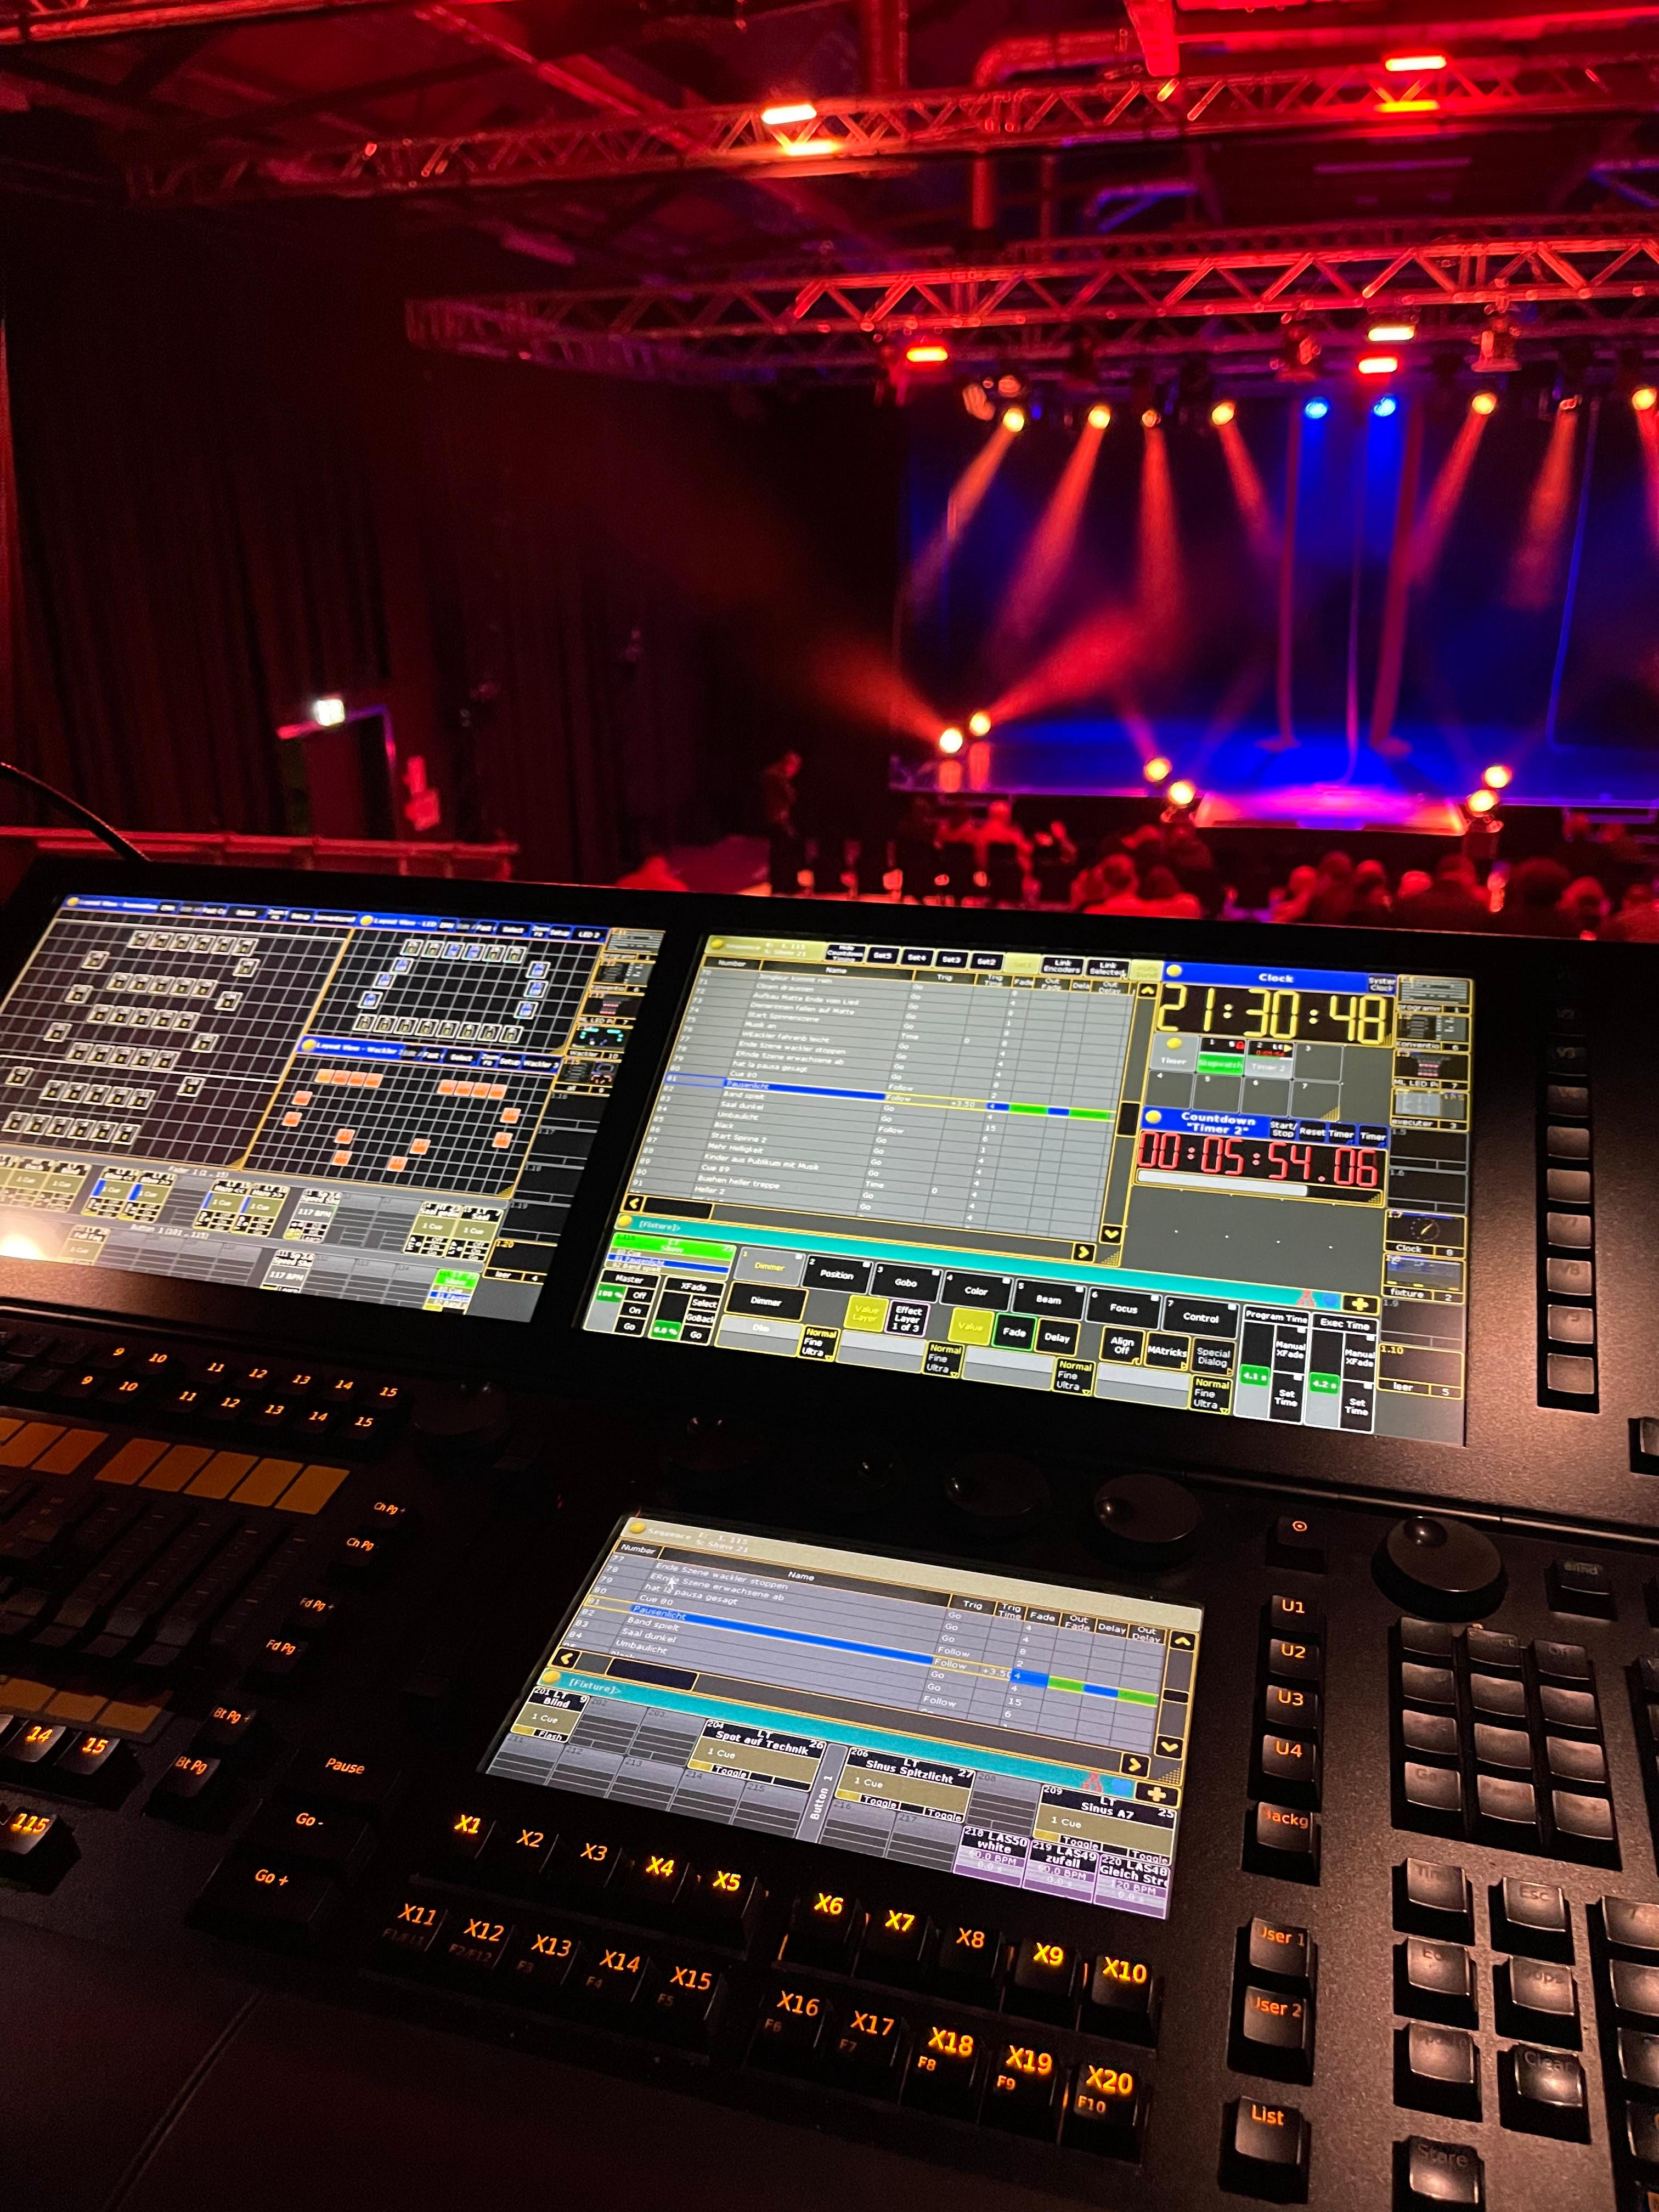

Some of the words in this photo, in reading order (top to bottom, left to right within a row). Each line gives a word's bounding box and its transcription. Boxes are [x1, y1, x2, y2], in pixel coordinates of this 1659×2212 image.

[1259, 973, 1294, 984] Clock
[1156, 983, 1385, 1045] 21:30:48
[1182, 1113, 1256, 1125] Countdown
[1269, 1120, 1297, 1131] Start/
[1272, 1128, 1295, 1138] Stop
[1300, 1127, 1325, 1137] Reset
[1360, 1131, 1387, 1142] Timer
[1137, 1130, 1378, 1188] 00:05:54.06
[754, 1262, 786, 1271] Dimmer
[614, 1275, 644, 1284] Master
[820, 1270, 854, 1280] Position
[681, 1283, 707, 1291] XFade
[895, 1278, 918, 1288] Gobo
[964, 1287, 989, 1296] Color
[1390, 1288, 1424, 1299] fixture
[1036, 1296, 1062, 1305] Beam
[895, 1306, 923, 1316] Effect
[1110, 1304, 1138, 1314] Focus
[894, 1314, 921, 1324] Layer
[1183, 1312, 1220, 1324] Control
[1246, 1310, 1283, 1322] Program
[1285, 1314, 1307, 1324] Time
[806, 1328, 837, 1338] Normal
[1003, 1328, 1026, 1338] Fade
[1045, 1333, 1071, 1344] Delay
[804, 1338, 822, 1347] Fine
[1110, 1338, 1135, 1348] Align
[1276, 1341, 1306, 1351] Manual
[149, 1353, 167, 1362] 10
[802, 1347, 823, 1357] Ultra
[1148, 1346, 1187, 1358] MAtricks
[1276, 1350, 1305, 1359] XFade
[208, 1363, 224, 1372] 11
[249, 1369, 267, 1378] 12
[293, 1375, 311, 1384] 13
[335, 1380, 353, 1389] 14
[380, 1387, 397, 1396] 15
[374, 1502, 385, 1511] Ch
[386, 1504, 398, 1515] Pg
[346, 1537, 359, 1547] Ch
[360, 1541, 374, 1551] Pg
[620, 1543, 655, 1555] Number
[655, 1563, 678, 1573] Ende
[682, 1567, 709, 1576] Szene
[712, 1571, 747, 1581] wackler
[749, 1577, 788, 1590] stoppen
[788, 1571, 815, 1582] Name
[682, 1577, 710, 1587] Szene
[712, 1582, 768, 1595] erwachsene
[639, 1594, 657, 1602] Cue
[645, 1583, 661, 1592] hat
[674, 1588, 703, 1600] pausa
[705, 1594, 738, 1606] gesagt
[300, 1598, 312, 1608] Fd
[312, 1600, 325, 1612] Pg
[633, 1604, 686, 1620] Pausenlicht
[963, 1600, 983, 1611] Trig
[1282, 1599, 1305, 1613] U1
[627, 1616, 650, 1628] Band
[652, 1620, 680, 1633] spielt
[1030, 1612, 1056, 1623] Fade
[622, 1628, 644, 1639] Saal
[645, 1632, 677, 1644] dunkel
[1098, 1623, 1126, 1635] Delay
[615, 1640, 667, 1654] Umbaulicht
[1281, 1644, 1306, 1658] U2
[543, 1697, 570, 1708] Blind
[1278, 1690, 1304, 1706] U3
[213, 1707, 225, 1718] Bt
[226, 1711, 241, 1724] Pg
[27, 1726, 54, 1742] 14
[538, 1731, 562, 1741] Flash
[82, 1737, 109, 1755] 15
[716, 1730, 742, 1743] Spot
[744, 1737, 763, 1746] auf
[766, 1740, 809, 1755] Technik
[1276, 1740, 1302, 1757] U4
[175, 1756, 191, 1768] Bt
[191, 1760, 208, 1774] Pg
[325, 1758, 364, 1774] Pause
[715, 1765, 747, 1778] Toggle
[866, 1759, 896, 1773] Sinus
[900, 1765, 953, 1784] Spitzlicht
[1081, 1802, 1113, 1815] Sinus
[1118, 1810, 1134, 1819] A7
[12, 1813, 50, 1833] 115
[296, 1813, 315, 1827] Go
[454, 1814, 481, 1834] X1
[516, 1830, 543, 1847] X2
[965, 1827, 984, 1837] 218
[988, 1832, 1028, 1847] LAS50
[580, 1843, 607, 1861] X3
[978, 1840, 1012, 1854] white
[1032, 1841, 1052, 1851] 219
[1057, 1847, 1097, 1861] LAS49
[646, 1856, 674, 1877] X4
[1046, 1854, 1080, 1868] zufall
[1102, 1856, 1122, 1866] 220
[1126, 1861, 1168, 1876] LAS48
[255, 1869, 275, 1884] Go
[279, 1876, 289, 1886] +
[1100, 1866, 1139, 1881] Gleich
[713, 1871, 741, 1891] X5
[814, 1893, 843, 1915] X6
[398, 1904, 436, 1925] X11
[885, 1910, 915, 1932] X7
[464, 1919, 504, 1941] X12
[531, 1934, 571, 1956] X13
[956, 1928, 985, 1948] X8
[1297, 1932, 1305, 1946] 1
[600, 1950, 640, 1972] X14
[1034, 1943, 1063, 1966] X9
[1103, 1957, 1147, 1983] X10
[670, 1966, 712, 1990] X15
[777, 1991, 819, 2016] X16
[1293, 2002, 1302, 2018] 2
[851, 2011, 894, 2035] X17
[928, 2027, 973, 2057] X18
[917, 2057, 936, 2071] F8
[1006, 2045, 1052, 2075] X19
[997, 2076, 1015, 2090] F9
[1086, 2066, 1133, 2095] X20
[1077, 2096, 1105, 2113] F10
[1250, 2105, 1284, 2126] List
